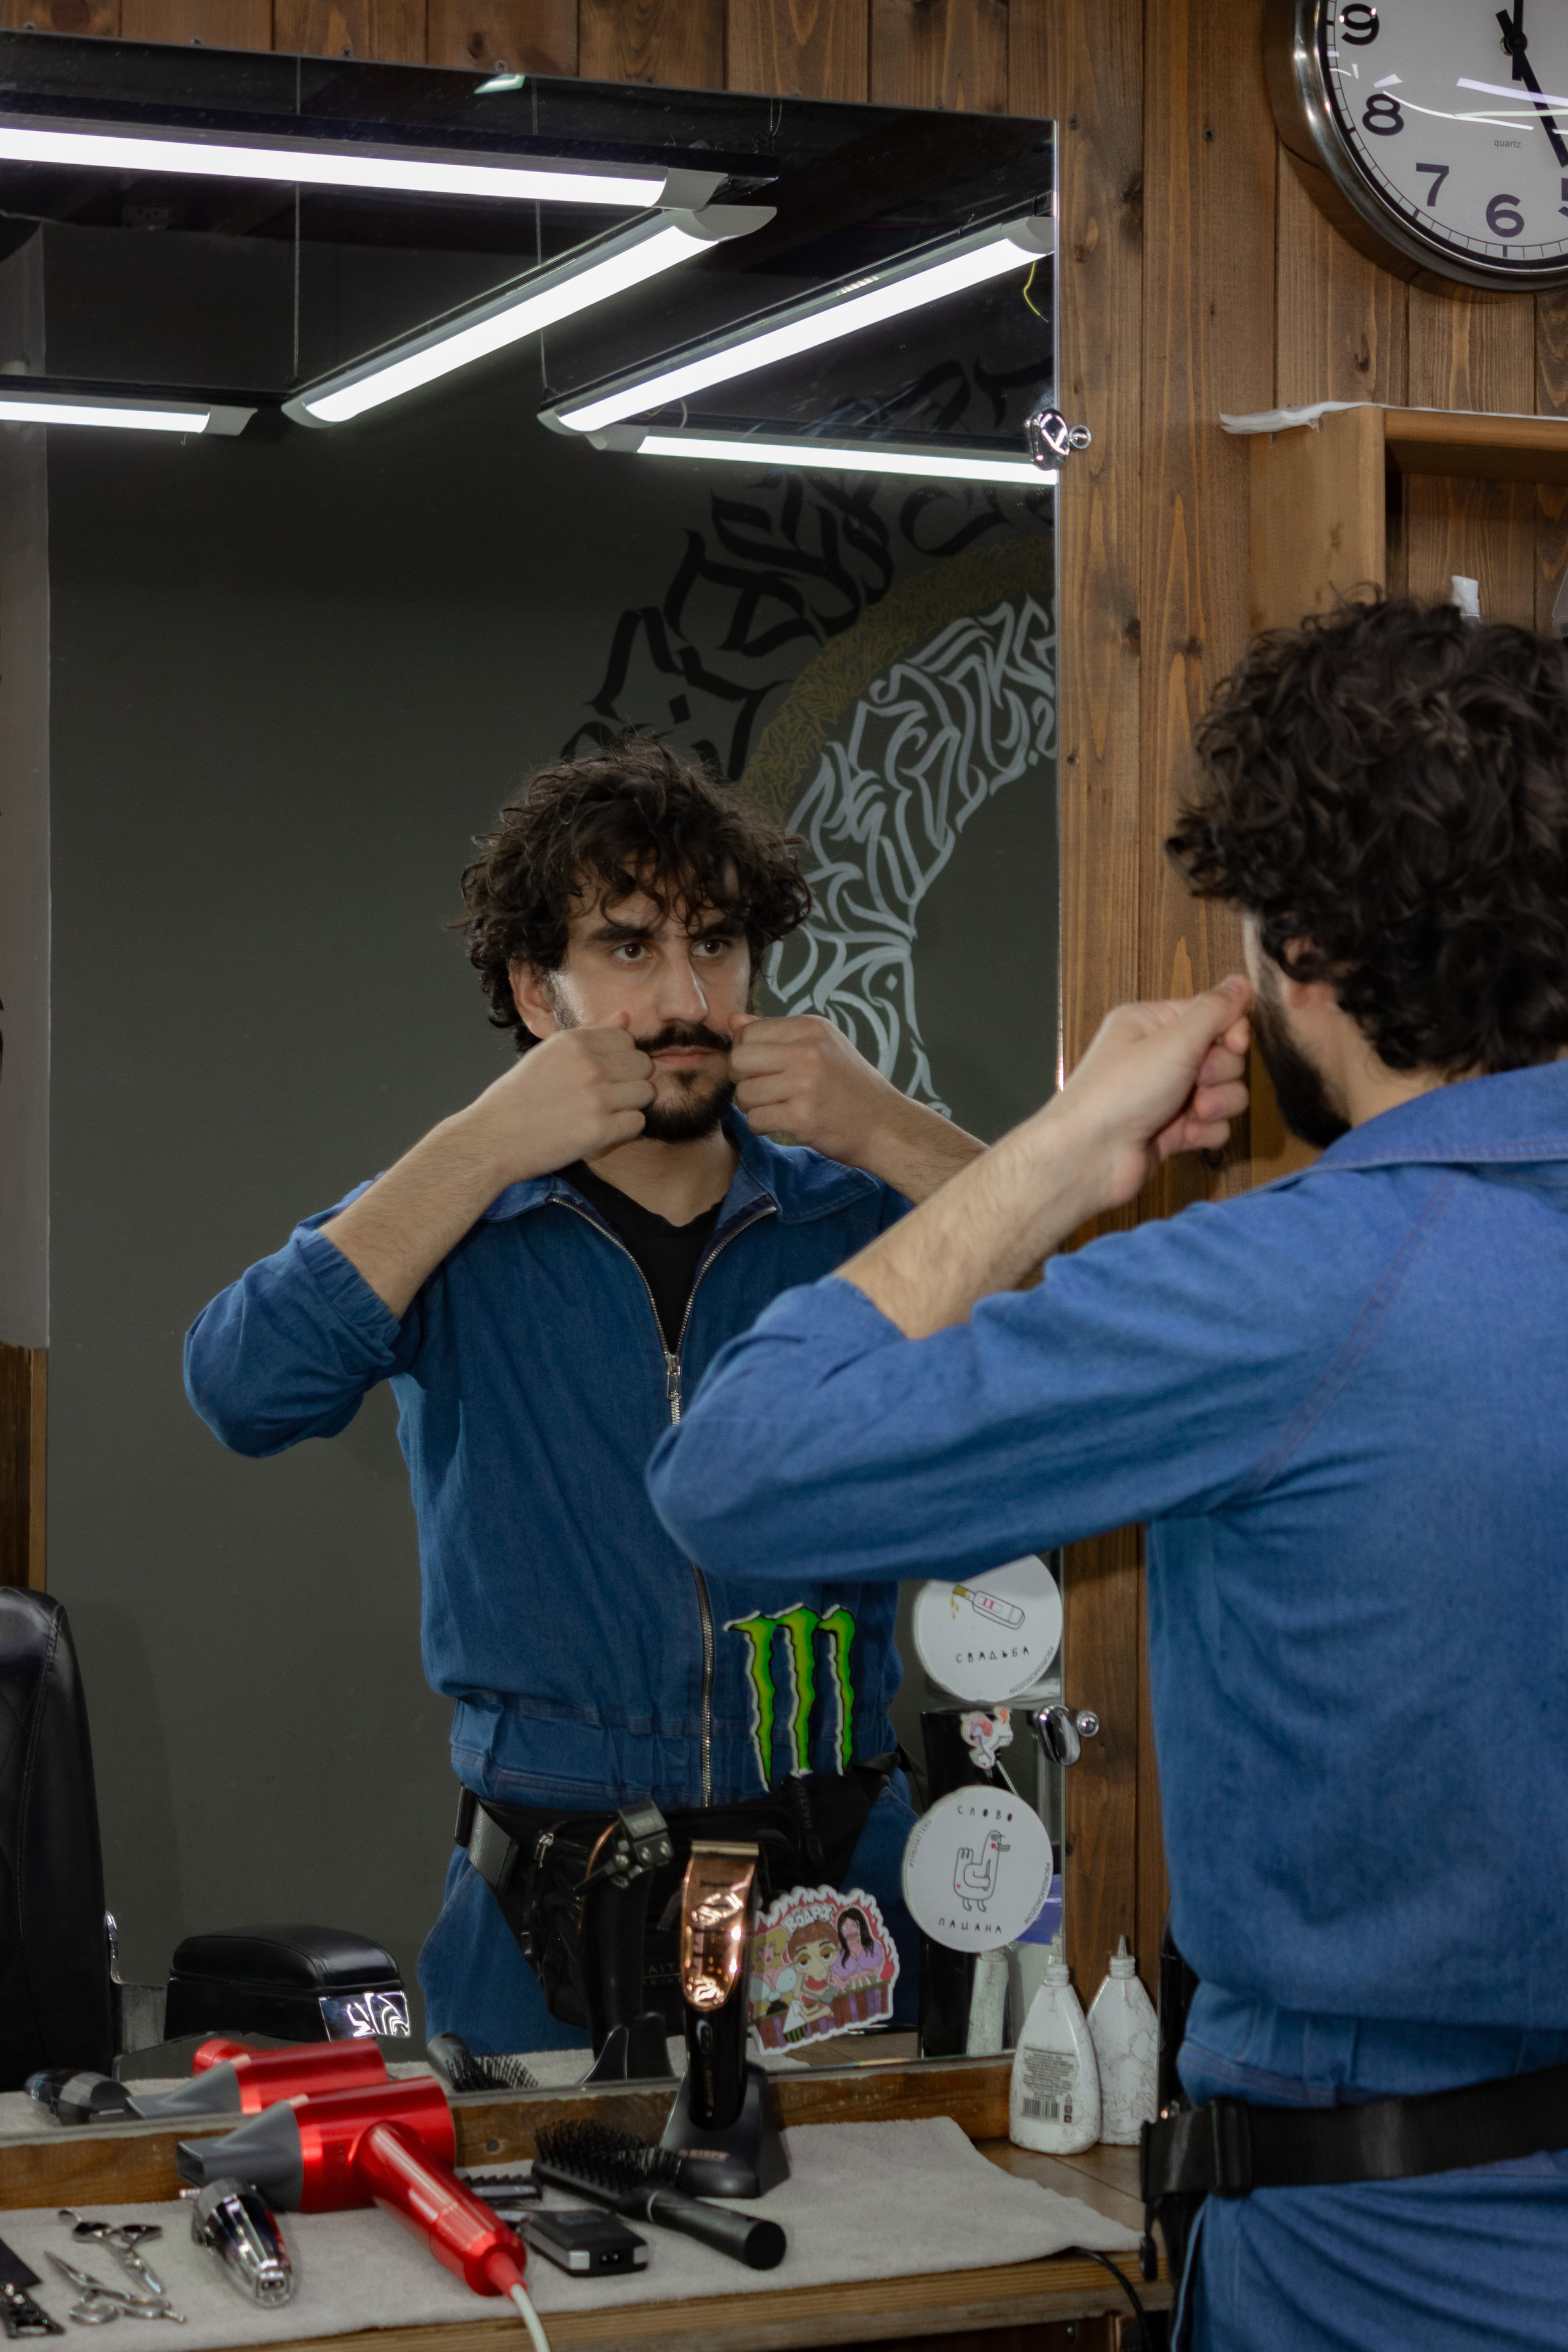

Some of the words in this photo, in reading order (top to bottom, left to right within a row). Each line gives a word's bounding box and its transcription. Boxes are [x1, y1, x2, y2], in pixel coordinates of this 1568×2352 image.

[1341, 3, 1380, 45] 9
[1362, 93, 1404, 136] 8
[1494, 139, 1521, 149] quartz
[1415, 162, 1450, 207] 7
[1485, 194, 1525, 238] 6
[956, 1646, 1030, 1664] СВАДЬБА
[957, 1804, 1013, 1822] СЛОВО
[938, 1917, 1002, 1934] ПАЦАНА
